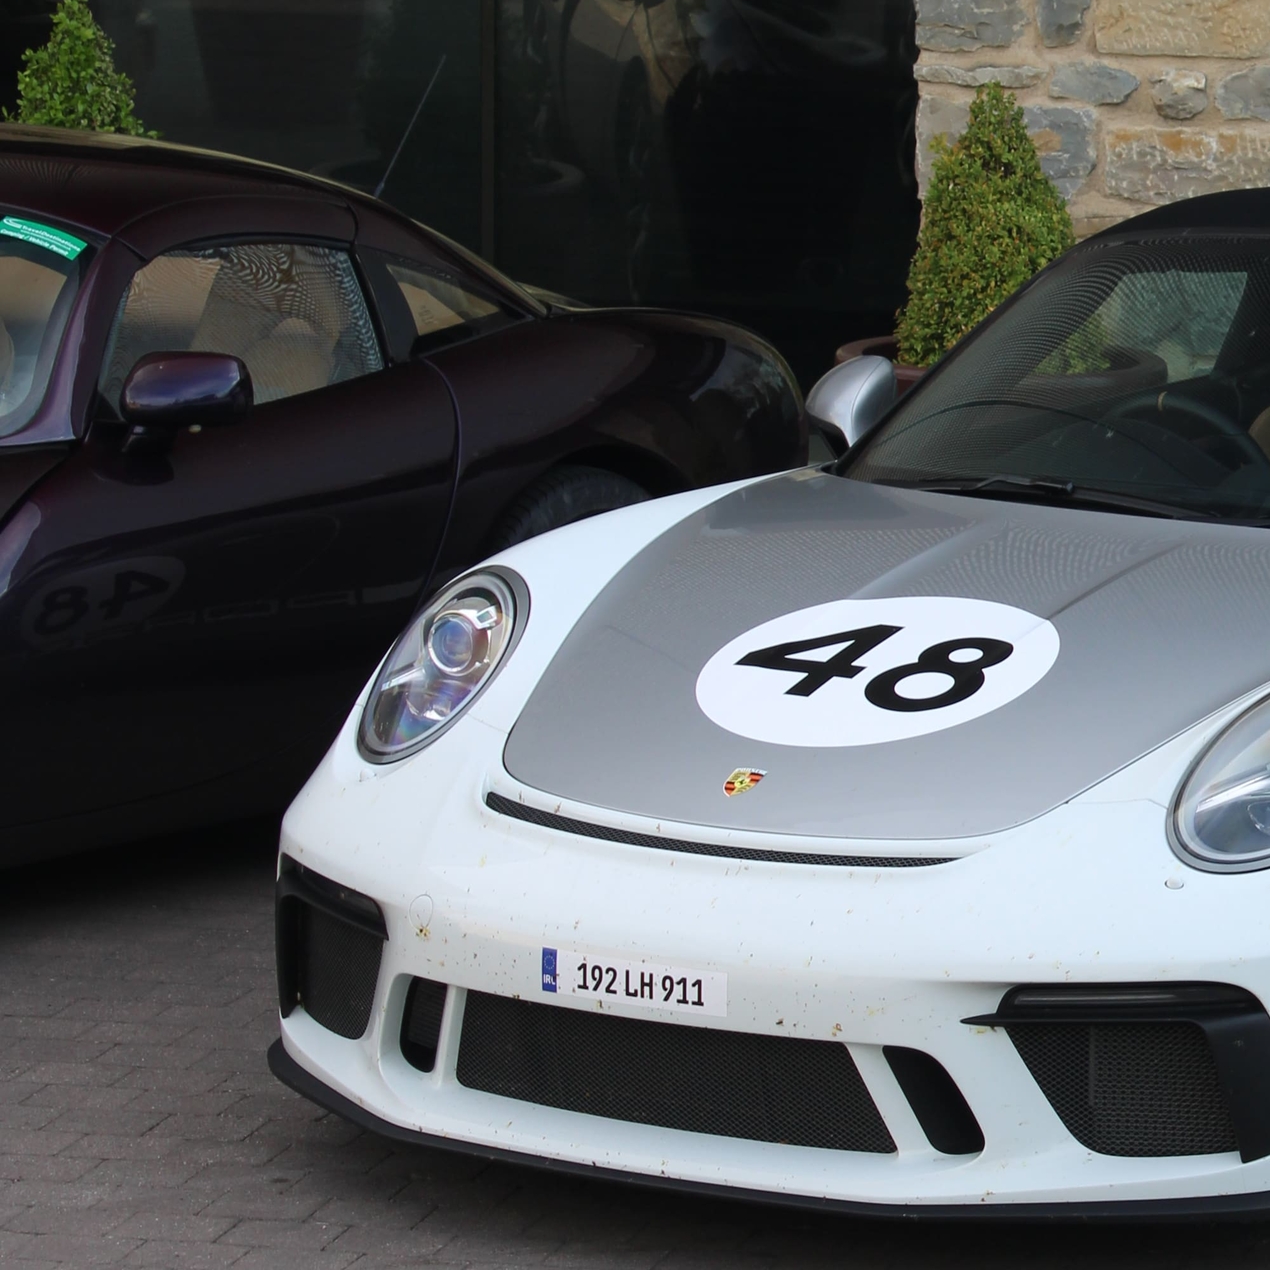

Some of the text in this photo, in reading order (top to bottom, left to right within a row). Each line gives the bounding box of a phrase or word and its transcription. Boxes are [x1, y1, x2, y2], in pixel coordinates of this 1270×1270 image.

[734, 624, 1014, 712] 48
[543, 973, 557, 985] IRL
[577, 962, 705, 1007] 192 LH 911
